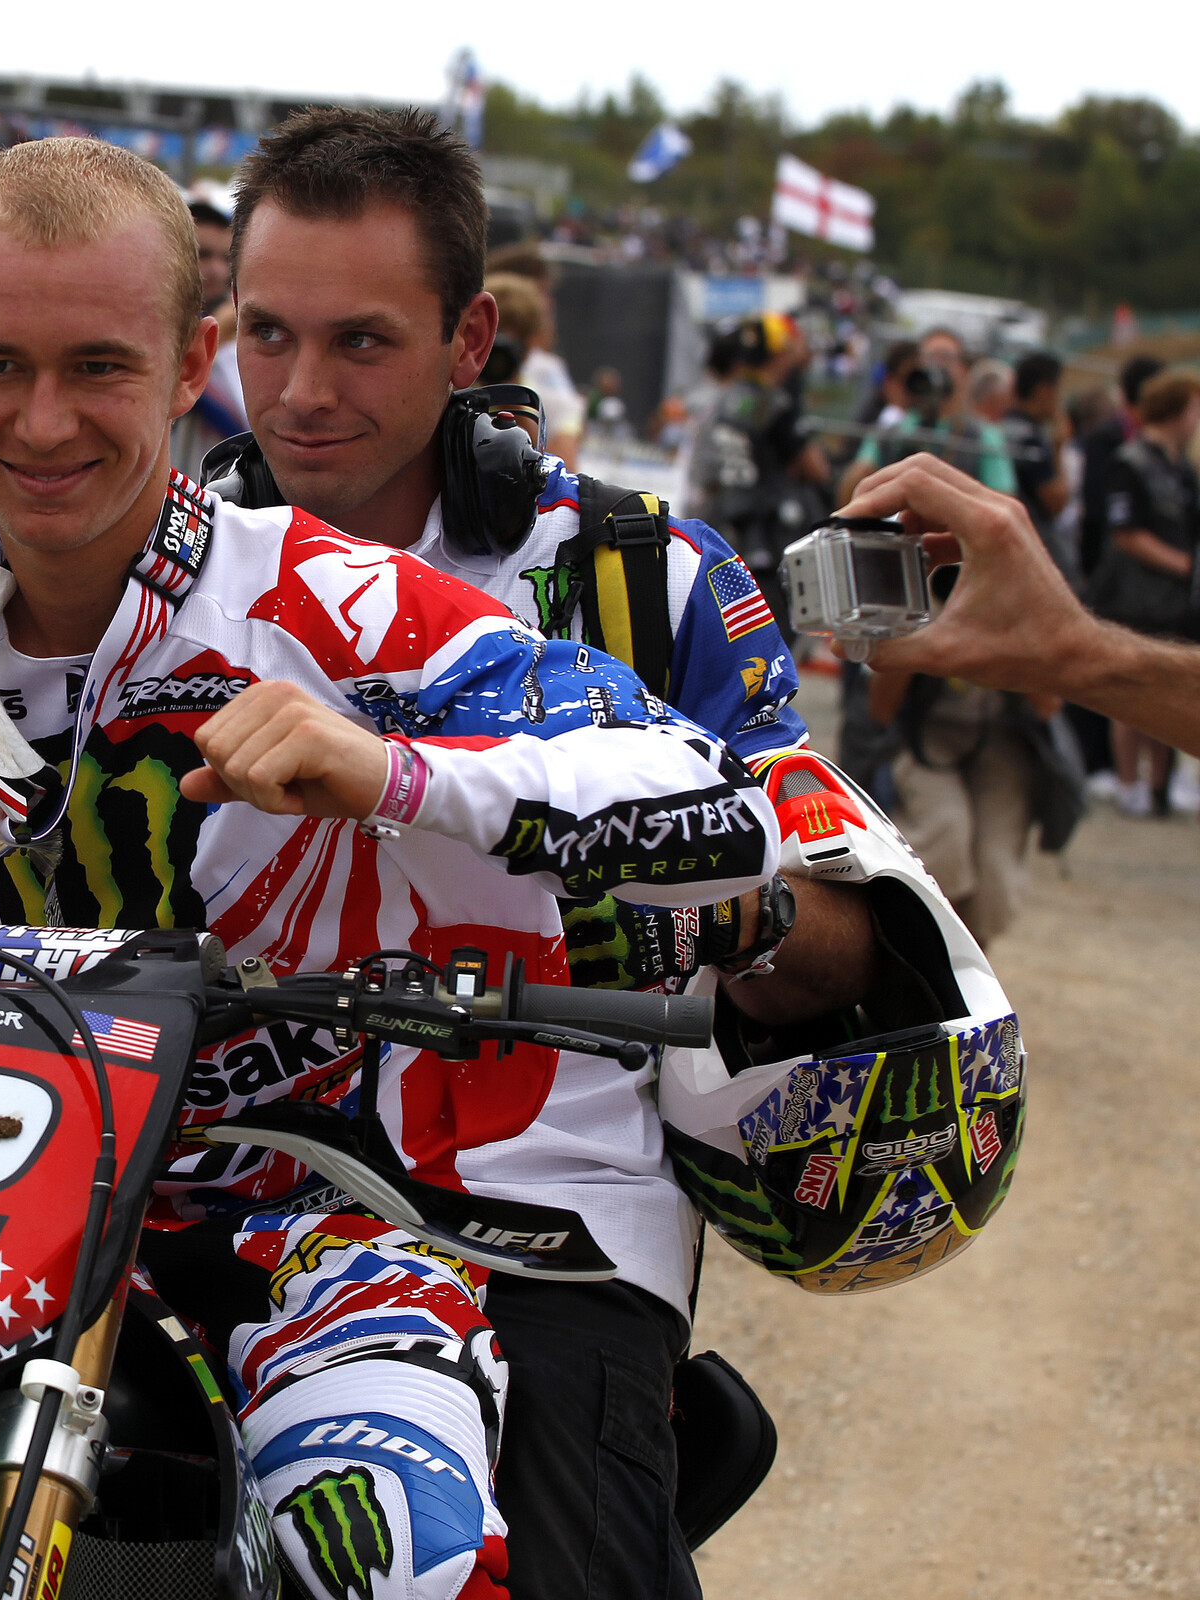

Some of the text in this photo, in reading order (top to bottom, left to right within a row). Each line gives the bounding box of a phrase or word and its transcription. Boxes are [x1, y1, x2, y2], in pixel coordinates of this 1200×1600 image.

[190, 524, 209, 569] FRANCE
[543, 795, 755, 868] MONSTER
[565, 853, 723, 888] ENERGY
[366, 1013, 454, 1039] SUNLINE
[968, 1111, 1002, 1175] VANS
[794, 1154, 845, 1211] VANS
[459, 1221, 571, 1249] UFO
[299, 1419, 467, 1484] thor
